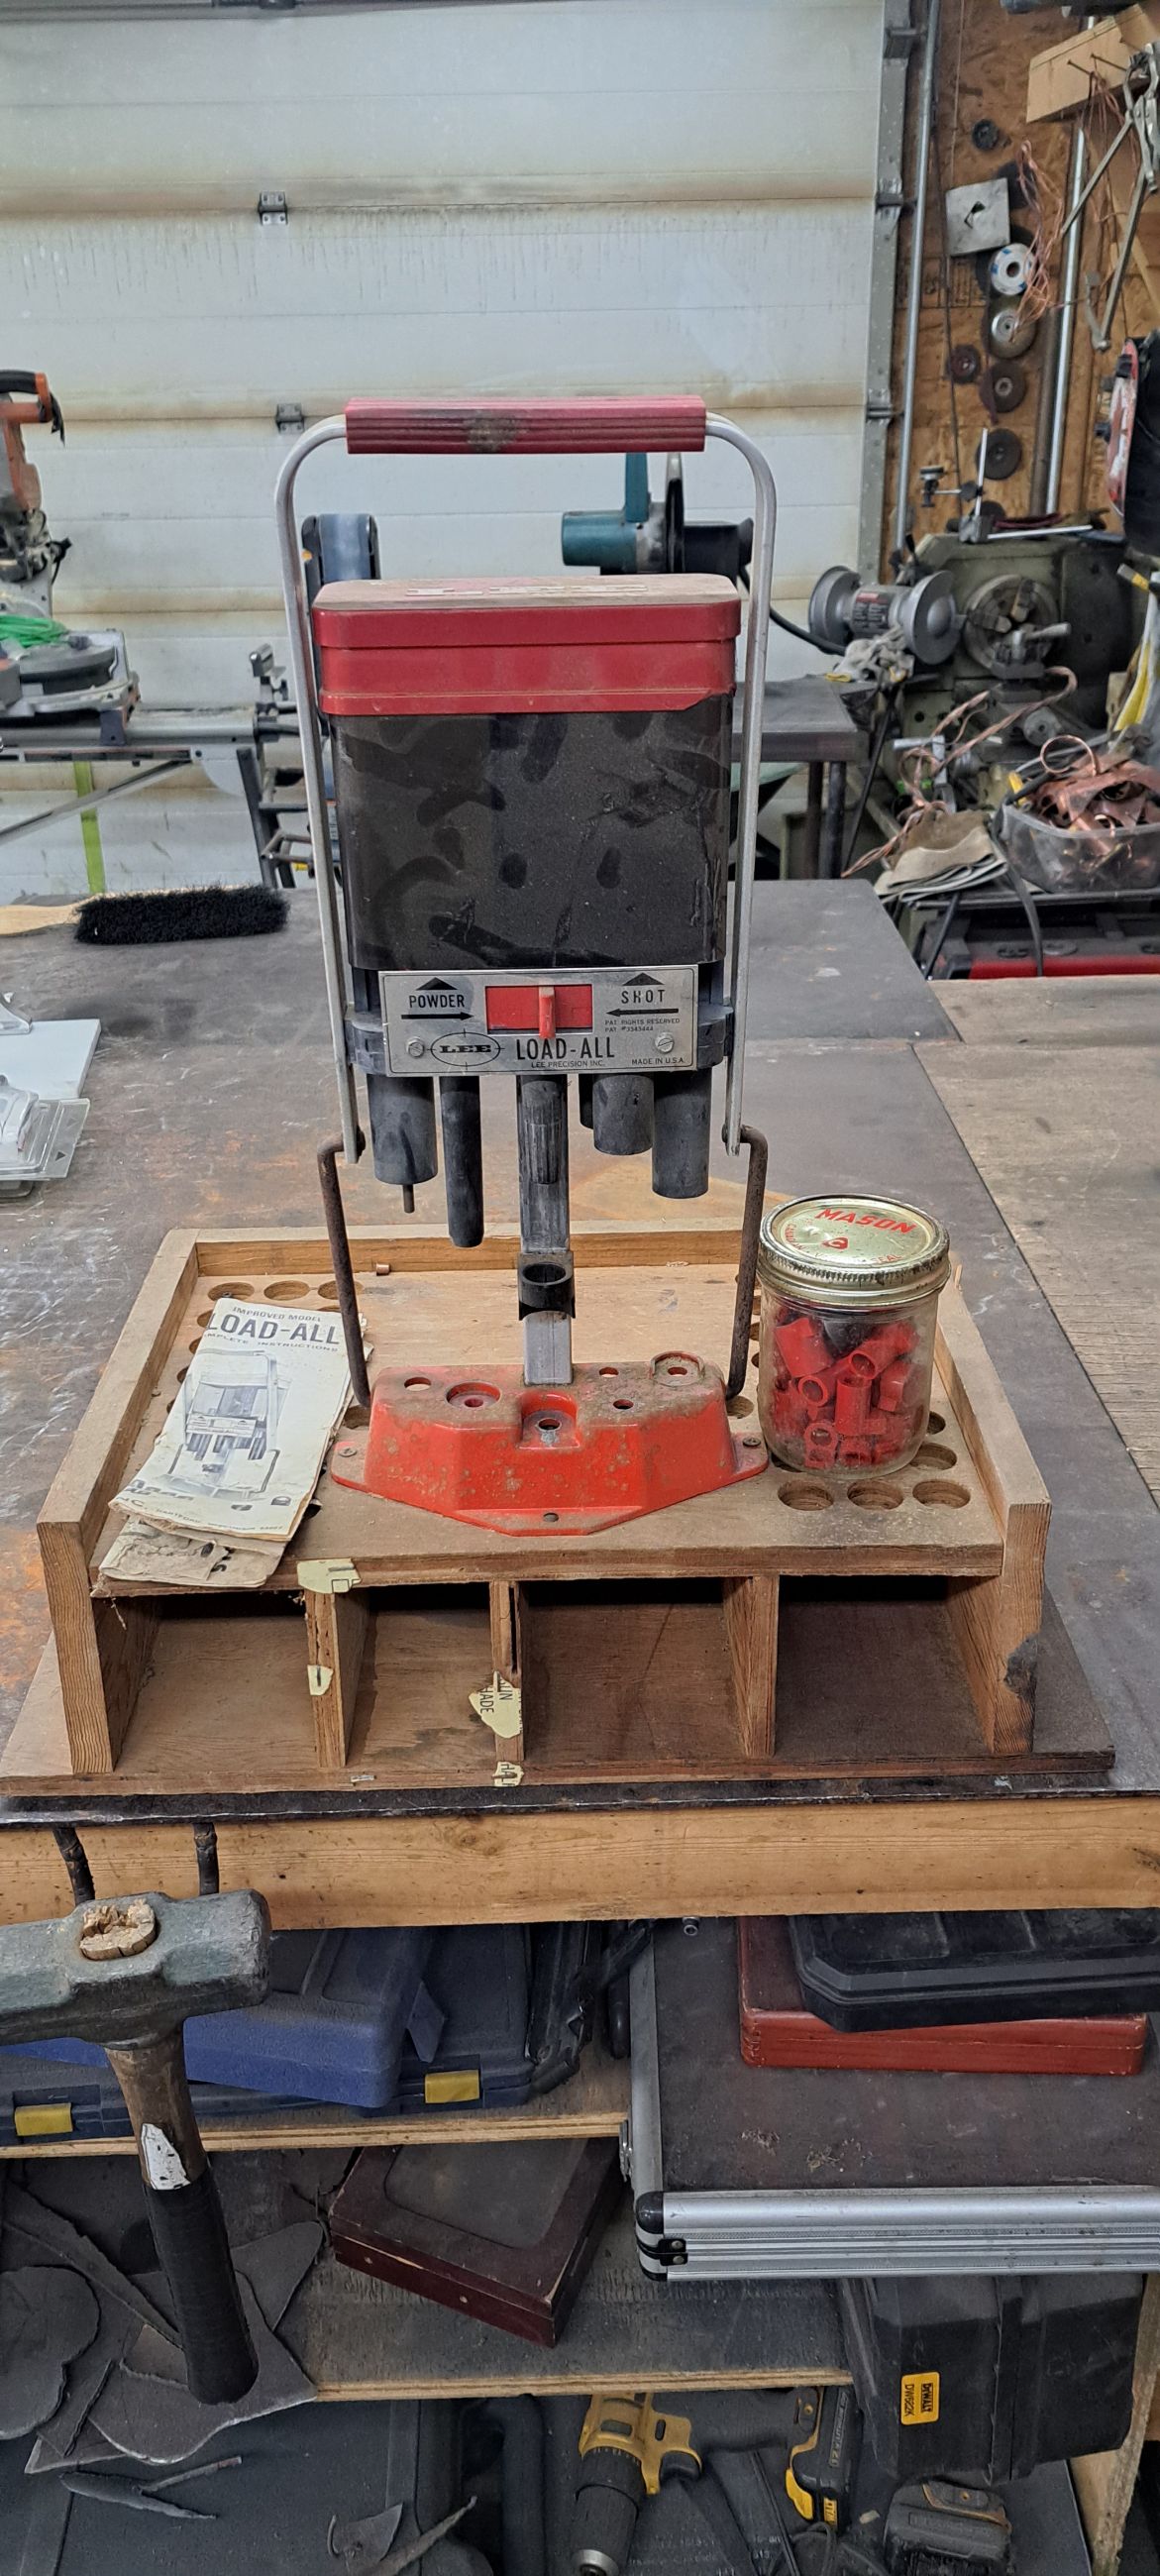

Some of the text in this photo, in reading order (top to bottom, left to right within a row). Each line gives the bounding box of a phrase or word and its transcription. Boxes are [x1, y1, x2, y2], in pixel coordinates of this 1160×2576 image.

[409, 994, 466, 1009] POWDER
[620, 989, 666, 1005] SHOT
[439, 1043, 492, 1054] LEE
[516, 1037, 615, 1060] LOAD-ALL
[530, 1060, 546, 1069] LEE
[547, 1059, 588, 1068] PRECISION
[815, 1208, 917, 1234] MASON
[232, 1306, 322, 1323] IMPROVED MODEL
[206, 1312, 340, 1345] LOAD-ALL
[258, 1342, 339, 1352] INSTRUCTIONS
